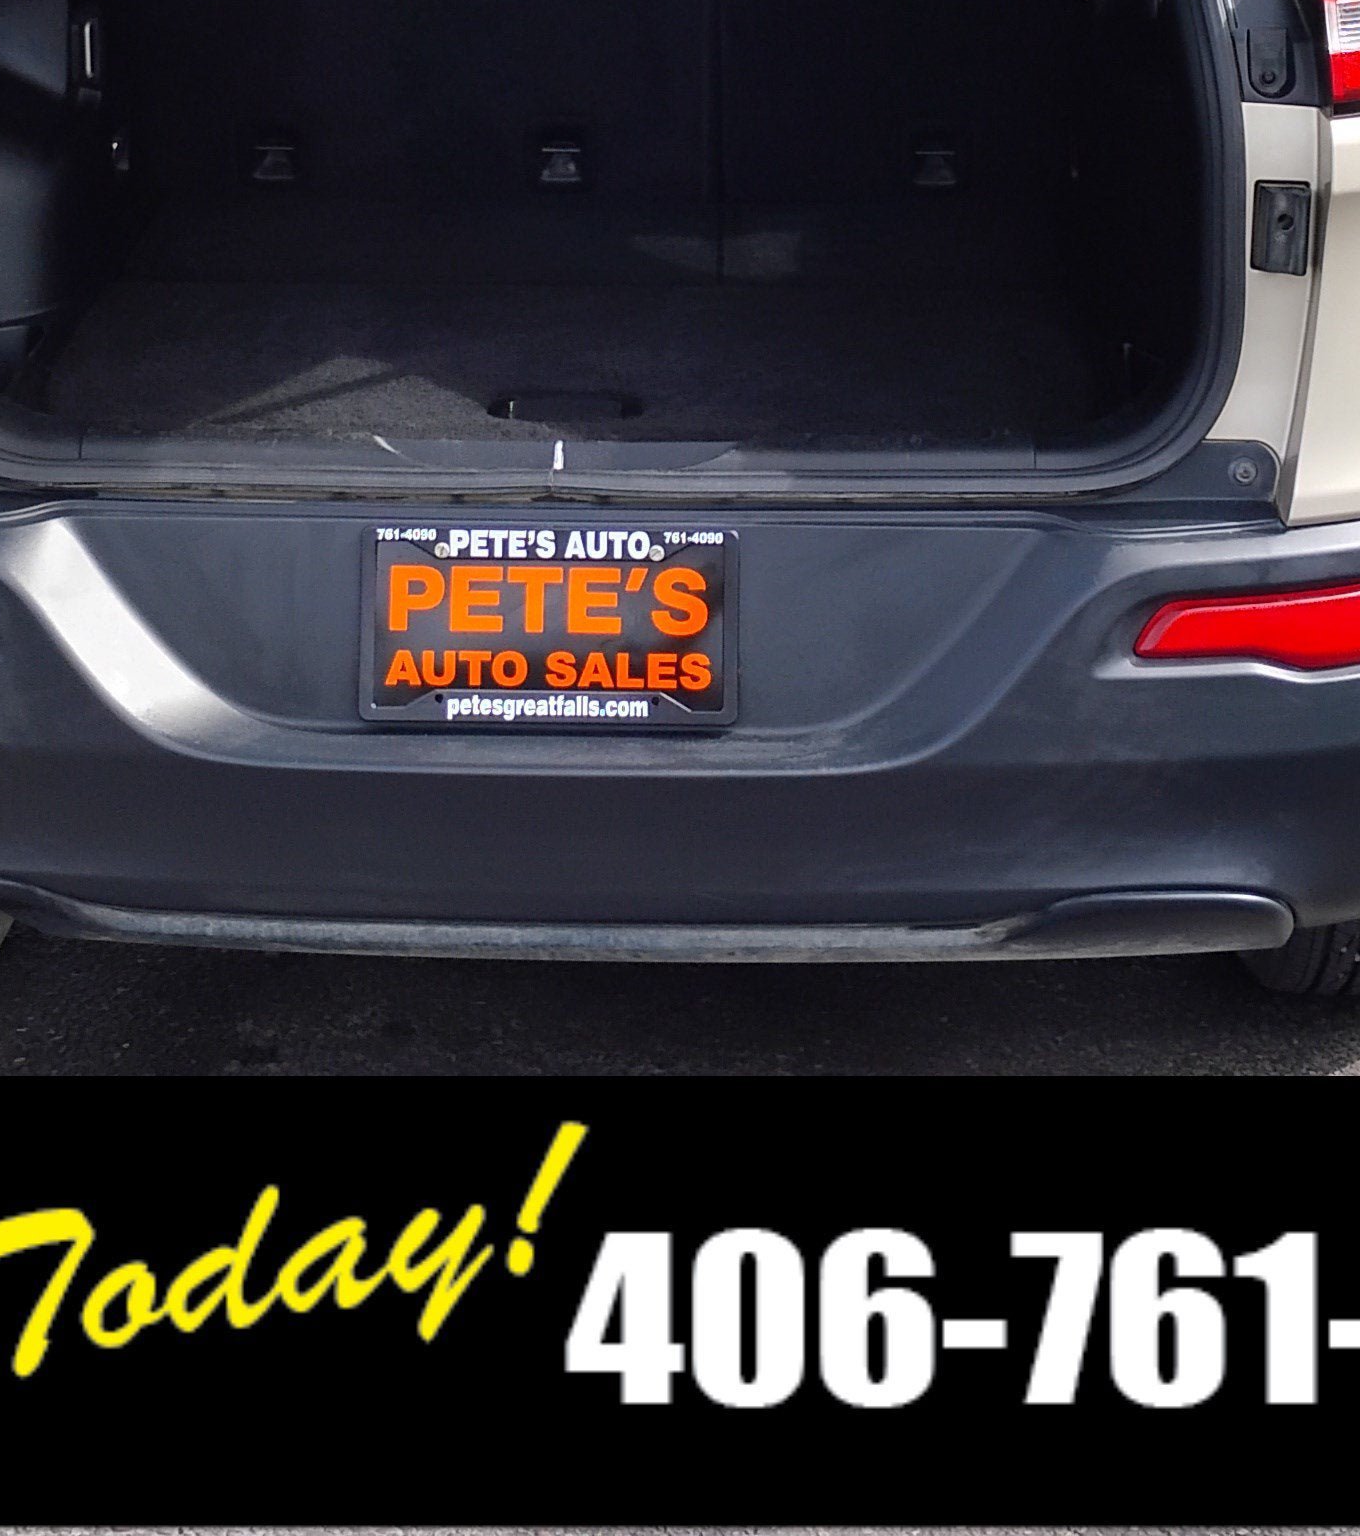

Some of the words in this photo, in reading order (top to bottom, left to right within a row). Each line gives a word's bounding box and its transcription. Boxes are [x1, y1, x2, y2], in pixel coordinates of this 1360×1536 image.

[376, 527, 437, 542] 761-4090
[448, 529, 556, 559] PETE'S
[564, 530, 651, 560] AUTO
[663, 531, 724, 545] 761-4090
[388, 565, 709, 636] PETE'S
[385, 650, 529, 686] AUTO
[545, 650, 712, 689] SALES
[447, 694, 649, 721] petesgreatfalls.com
